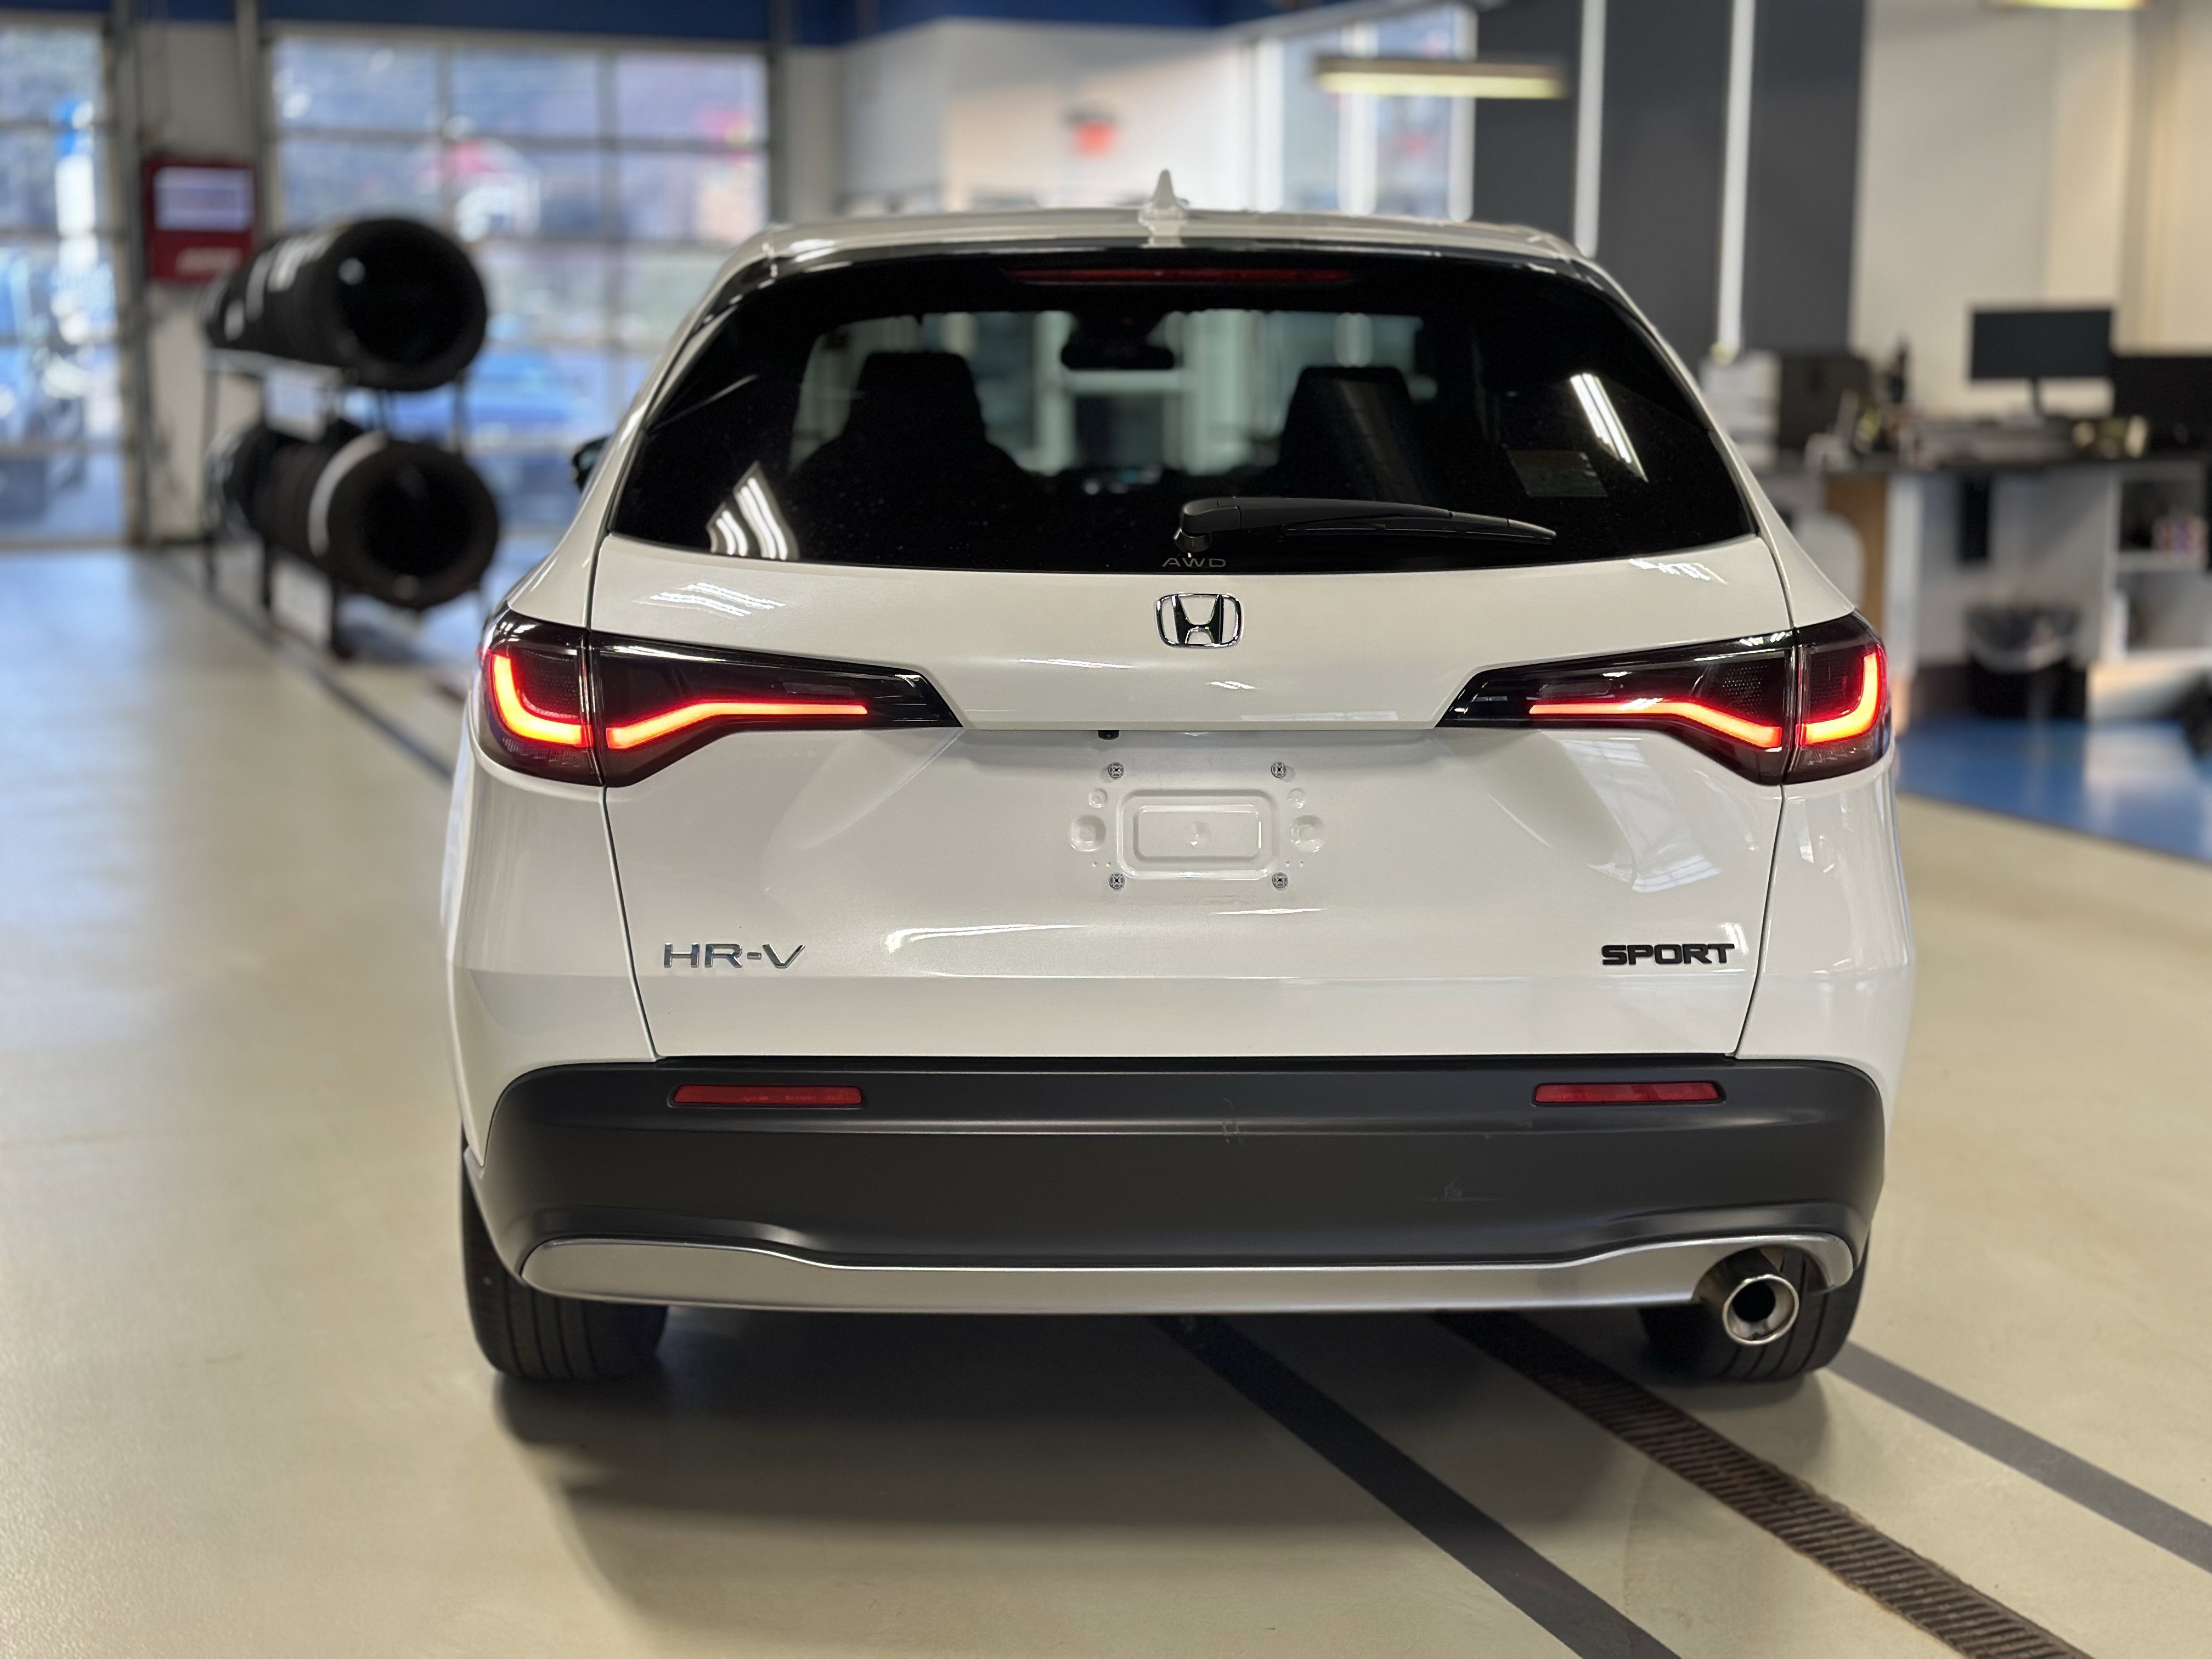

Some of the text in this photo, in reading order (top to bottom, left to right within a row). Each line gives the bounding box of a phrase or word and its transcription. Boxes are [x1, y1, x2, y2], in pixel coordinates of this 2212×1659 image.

[1162, 557, 1226, 568] AWD
[664, 943, 805, 968] HR-V
[1601, 943, 1735, 965] SPORT
